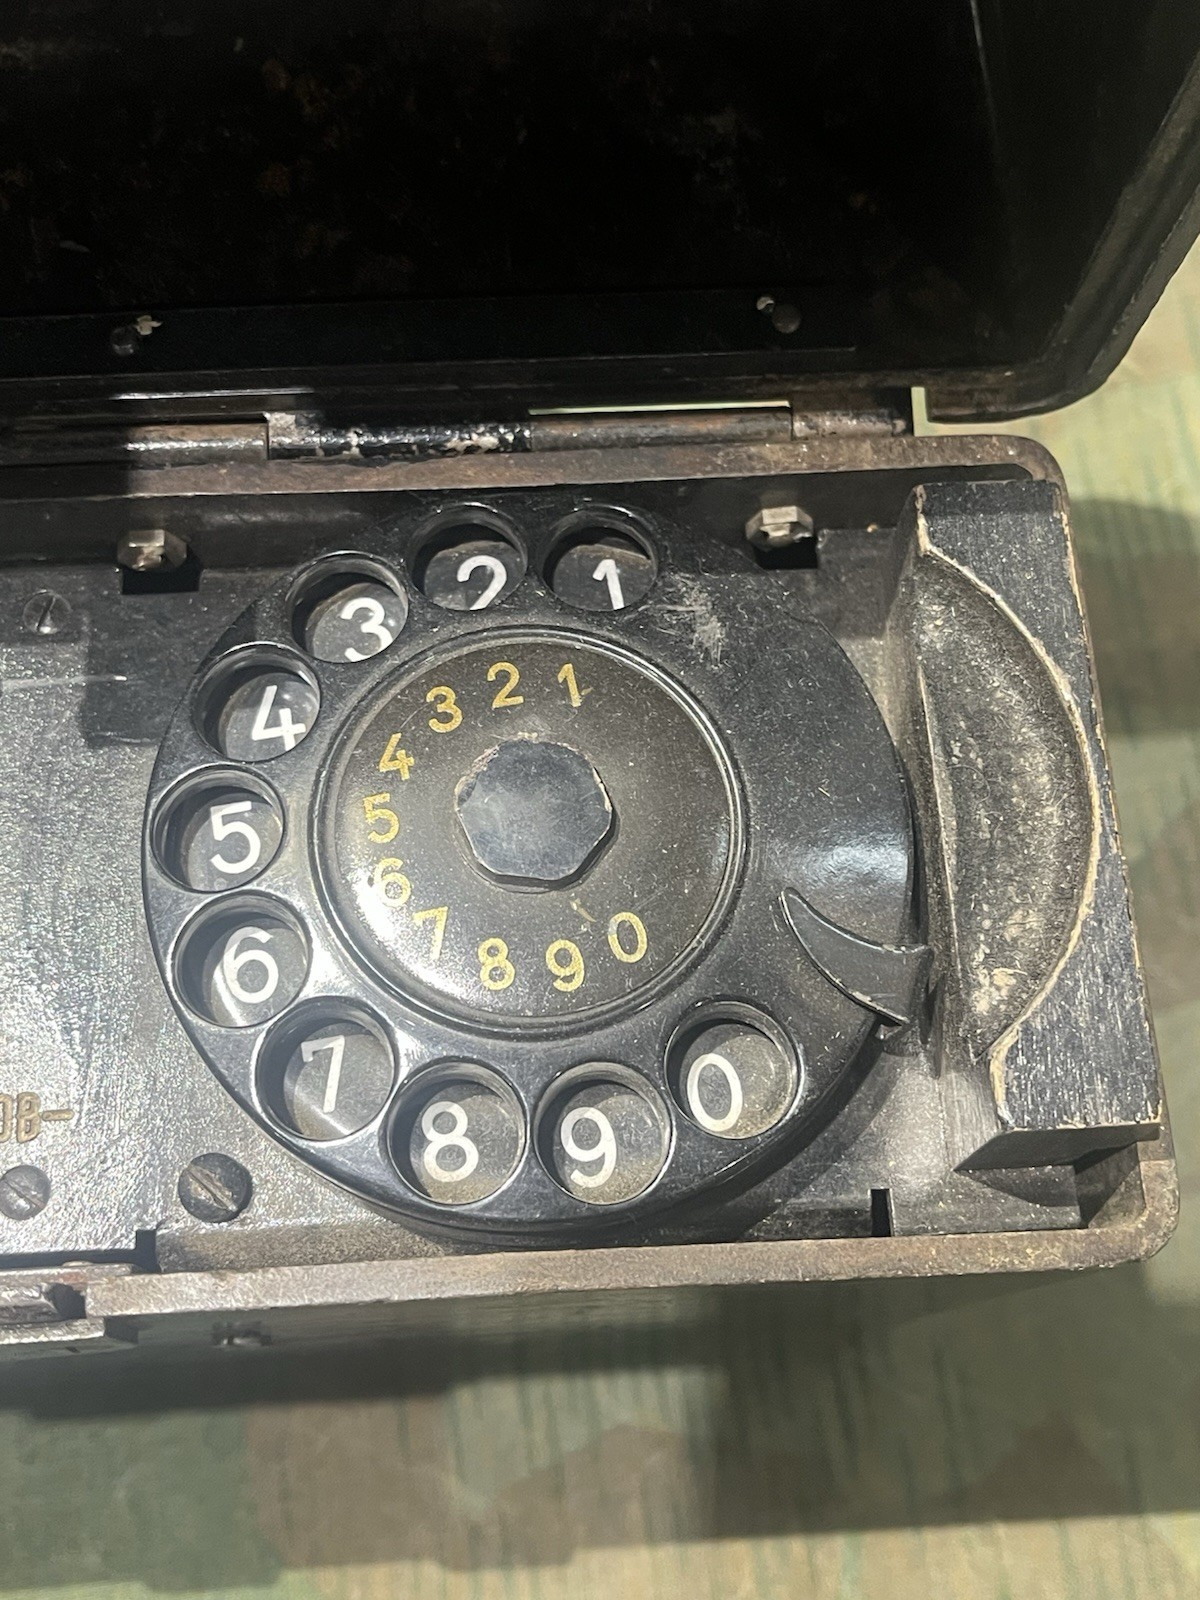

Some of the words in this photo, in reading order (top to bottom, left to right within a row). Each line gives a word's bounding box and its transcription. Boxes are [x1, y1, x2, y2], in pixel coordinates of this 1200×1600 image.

[592, 559, 625, 610] 1
[340, 597, 393, 662] 3
[426, 686, 463, 733] 3
[486, 661, 524, 709] 2
[557, 663, 582, 708] 1
[251, 685, 306, 751] 4
[379, 733, 414, 781] 4
[210, 801, 261, 874] 5
[363, 793, 399, 844] 5
[373, 857, 411, 907] 6
[413, 906, 448, 959] 7
[608, 912, 647, 963] 0
[223, 926, 279, 1003] 6
[477, 938, 516, 991] 8
[545, 939, 585, 992] 9
[301, 1035, 345, 1113] 7
[687, 1053, 743, 1132] 0
[421, 1101, 479, 1183] 8
[560, 1106, 617, 1188] 9
